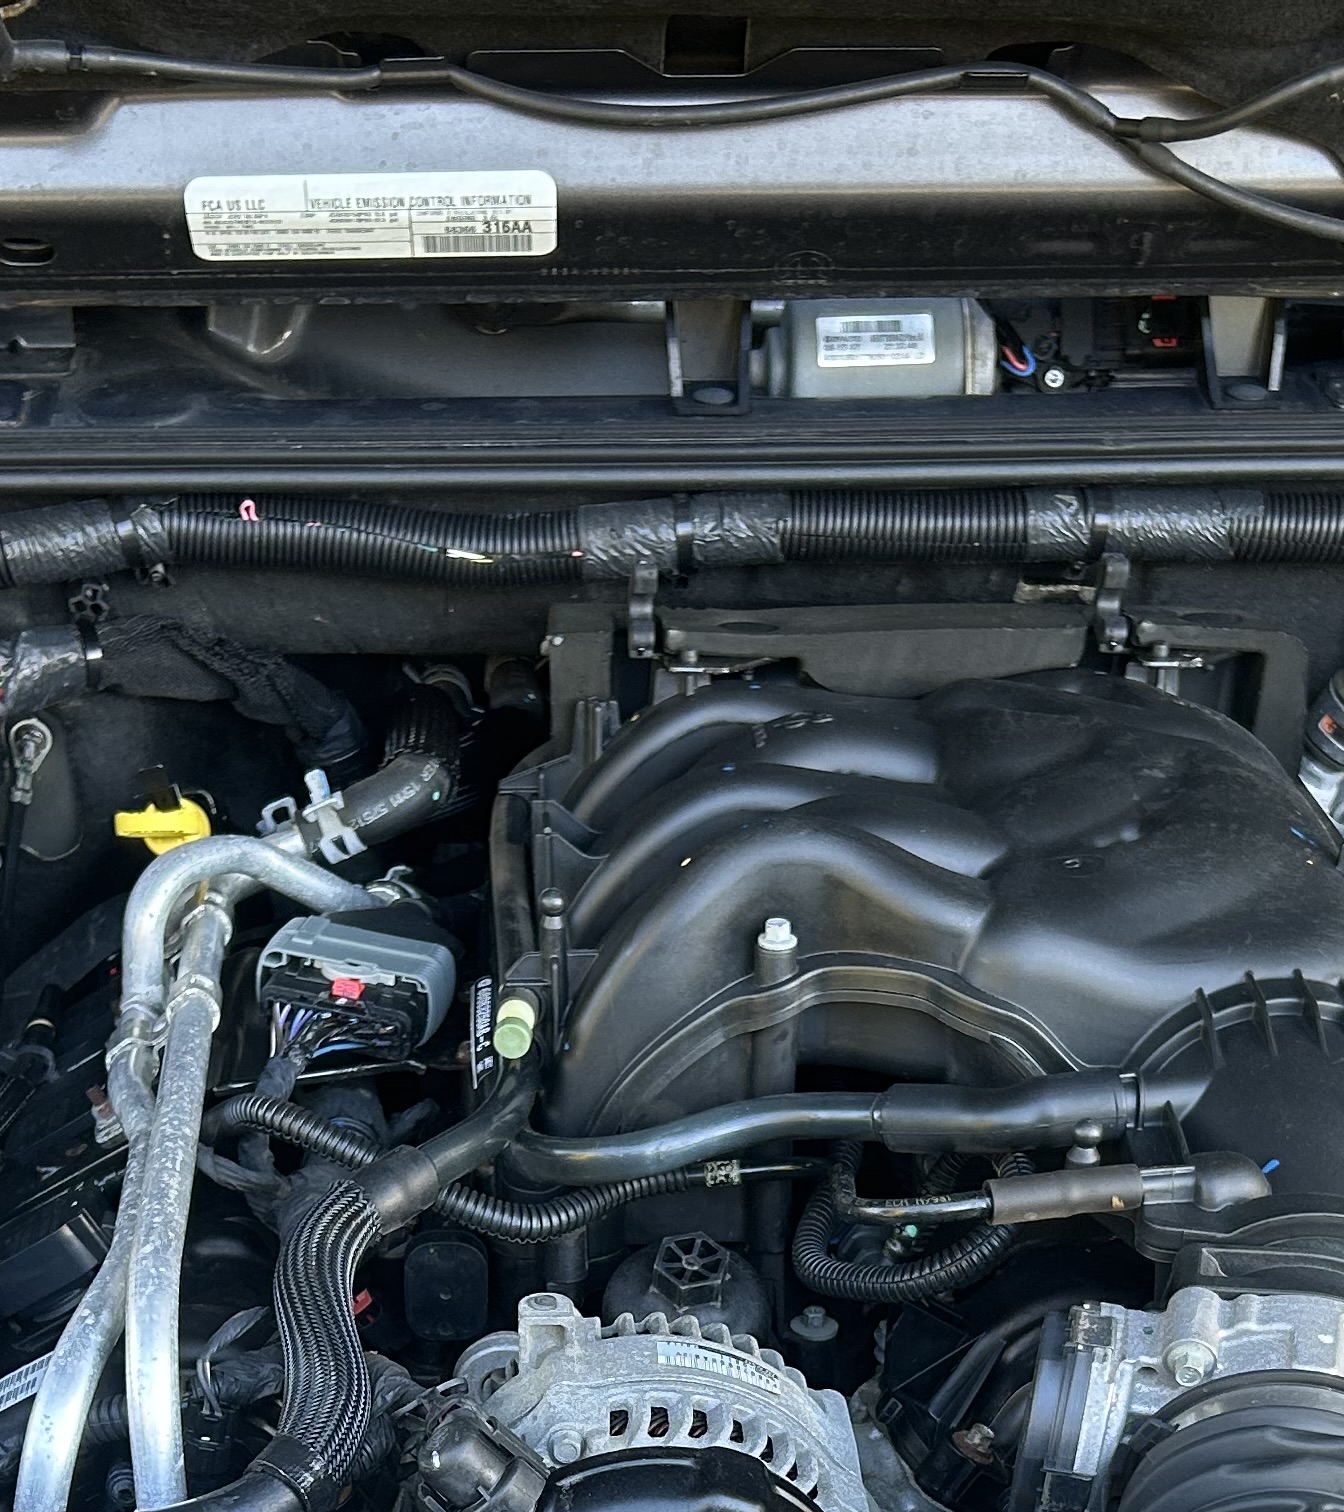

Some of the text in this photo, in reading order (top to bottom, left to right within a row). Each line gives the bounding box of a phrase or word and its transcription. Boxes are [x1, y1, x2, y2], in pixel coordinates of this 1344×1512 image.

[201, 199, 266, 211] FCA US LLC
[309, 194, 533, 209] VEHICLE EMISSION CONTROL INFORMATION
